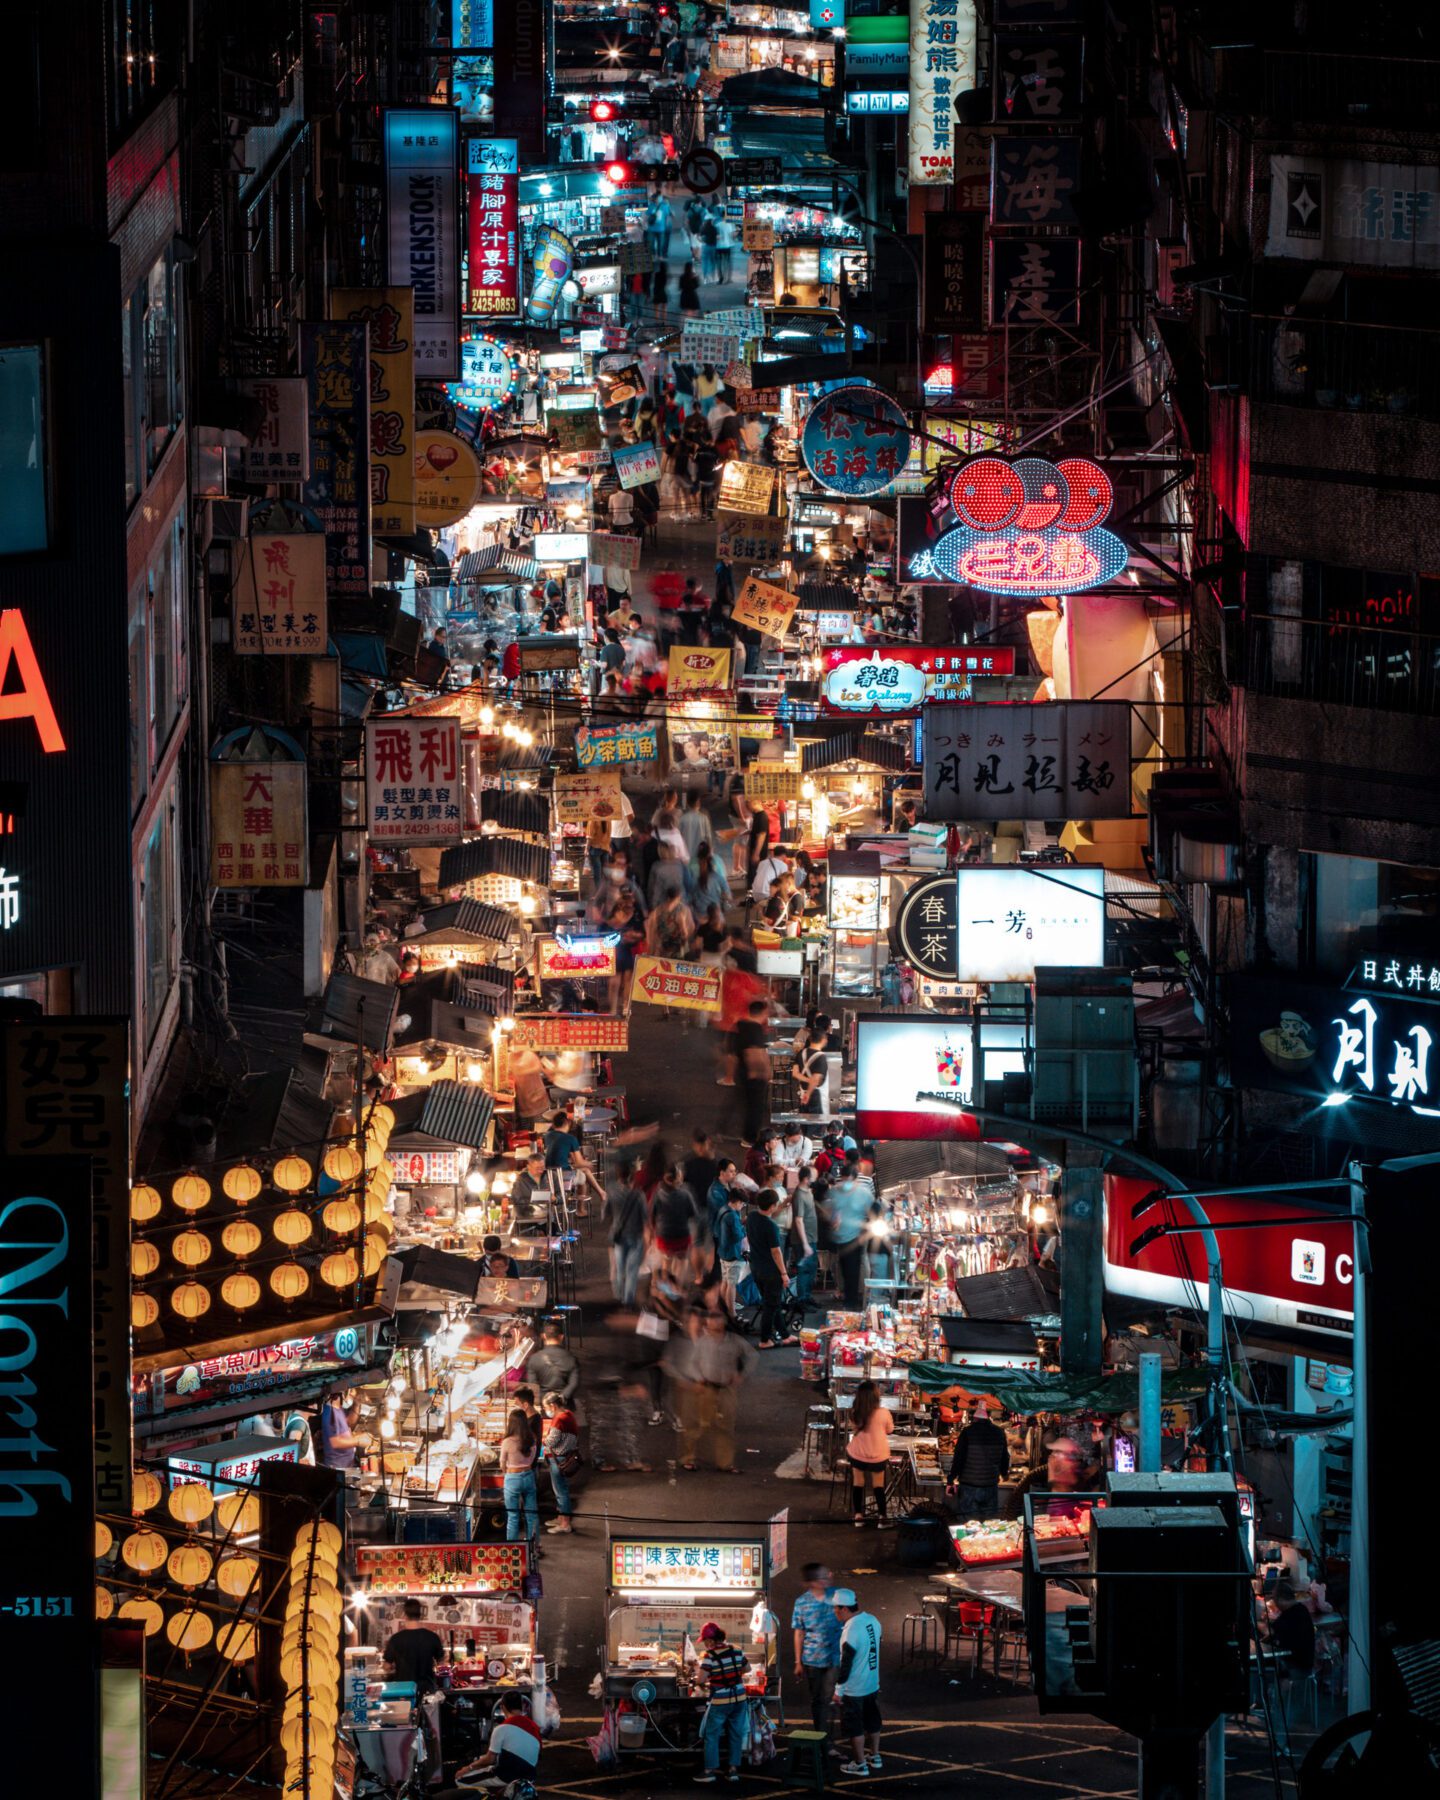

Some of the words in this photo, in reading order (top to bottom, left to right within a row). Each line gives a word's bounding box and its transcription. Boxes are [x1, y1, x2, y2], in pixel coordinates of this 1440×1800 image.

[925, 0, 959, 72] 湯姆熊
[872, 96, 889, 109] ATM
[403, 136, 439, 146] 基隆店
[920, 156, 953, 167] TOM
[409, 175, 435, 314] BIRKENSTOCK
[471, 298, 516, 312] 2425-0853
[463, 345, 494, 359] 三井
[818, 403, 897, 441] 松山
[813, 447, 900, 478] 活海鮮
[975, 536, 1085, 576] 三兄弟
[841, 688, 862, 701] ice
[375, 727, 456, 783] 飛利
[242, 772, 273, 836] 大華
[971, 909, 1027, 934] 一芳
[645, 975, 718, 999] 奶油螃蟹
[338, 1332, 354, 1354] 68
[201, 1336, 317, 1380] 章魚小丸子
[229, 1374, 290, 1393] takoyaki
[646, 1546, 721, 1567] 陳家碳烤
[351, 1677, 368, 1724] 石花凍
